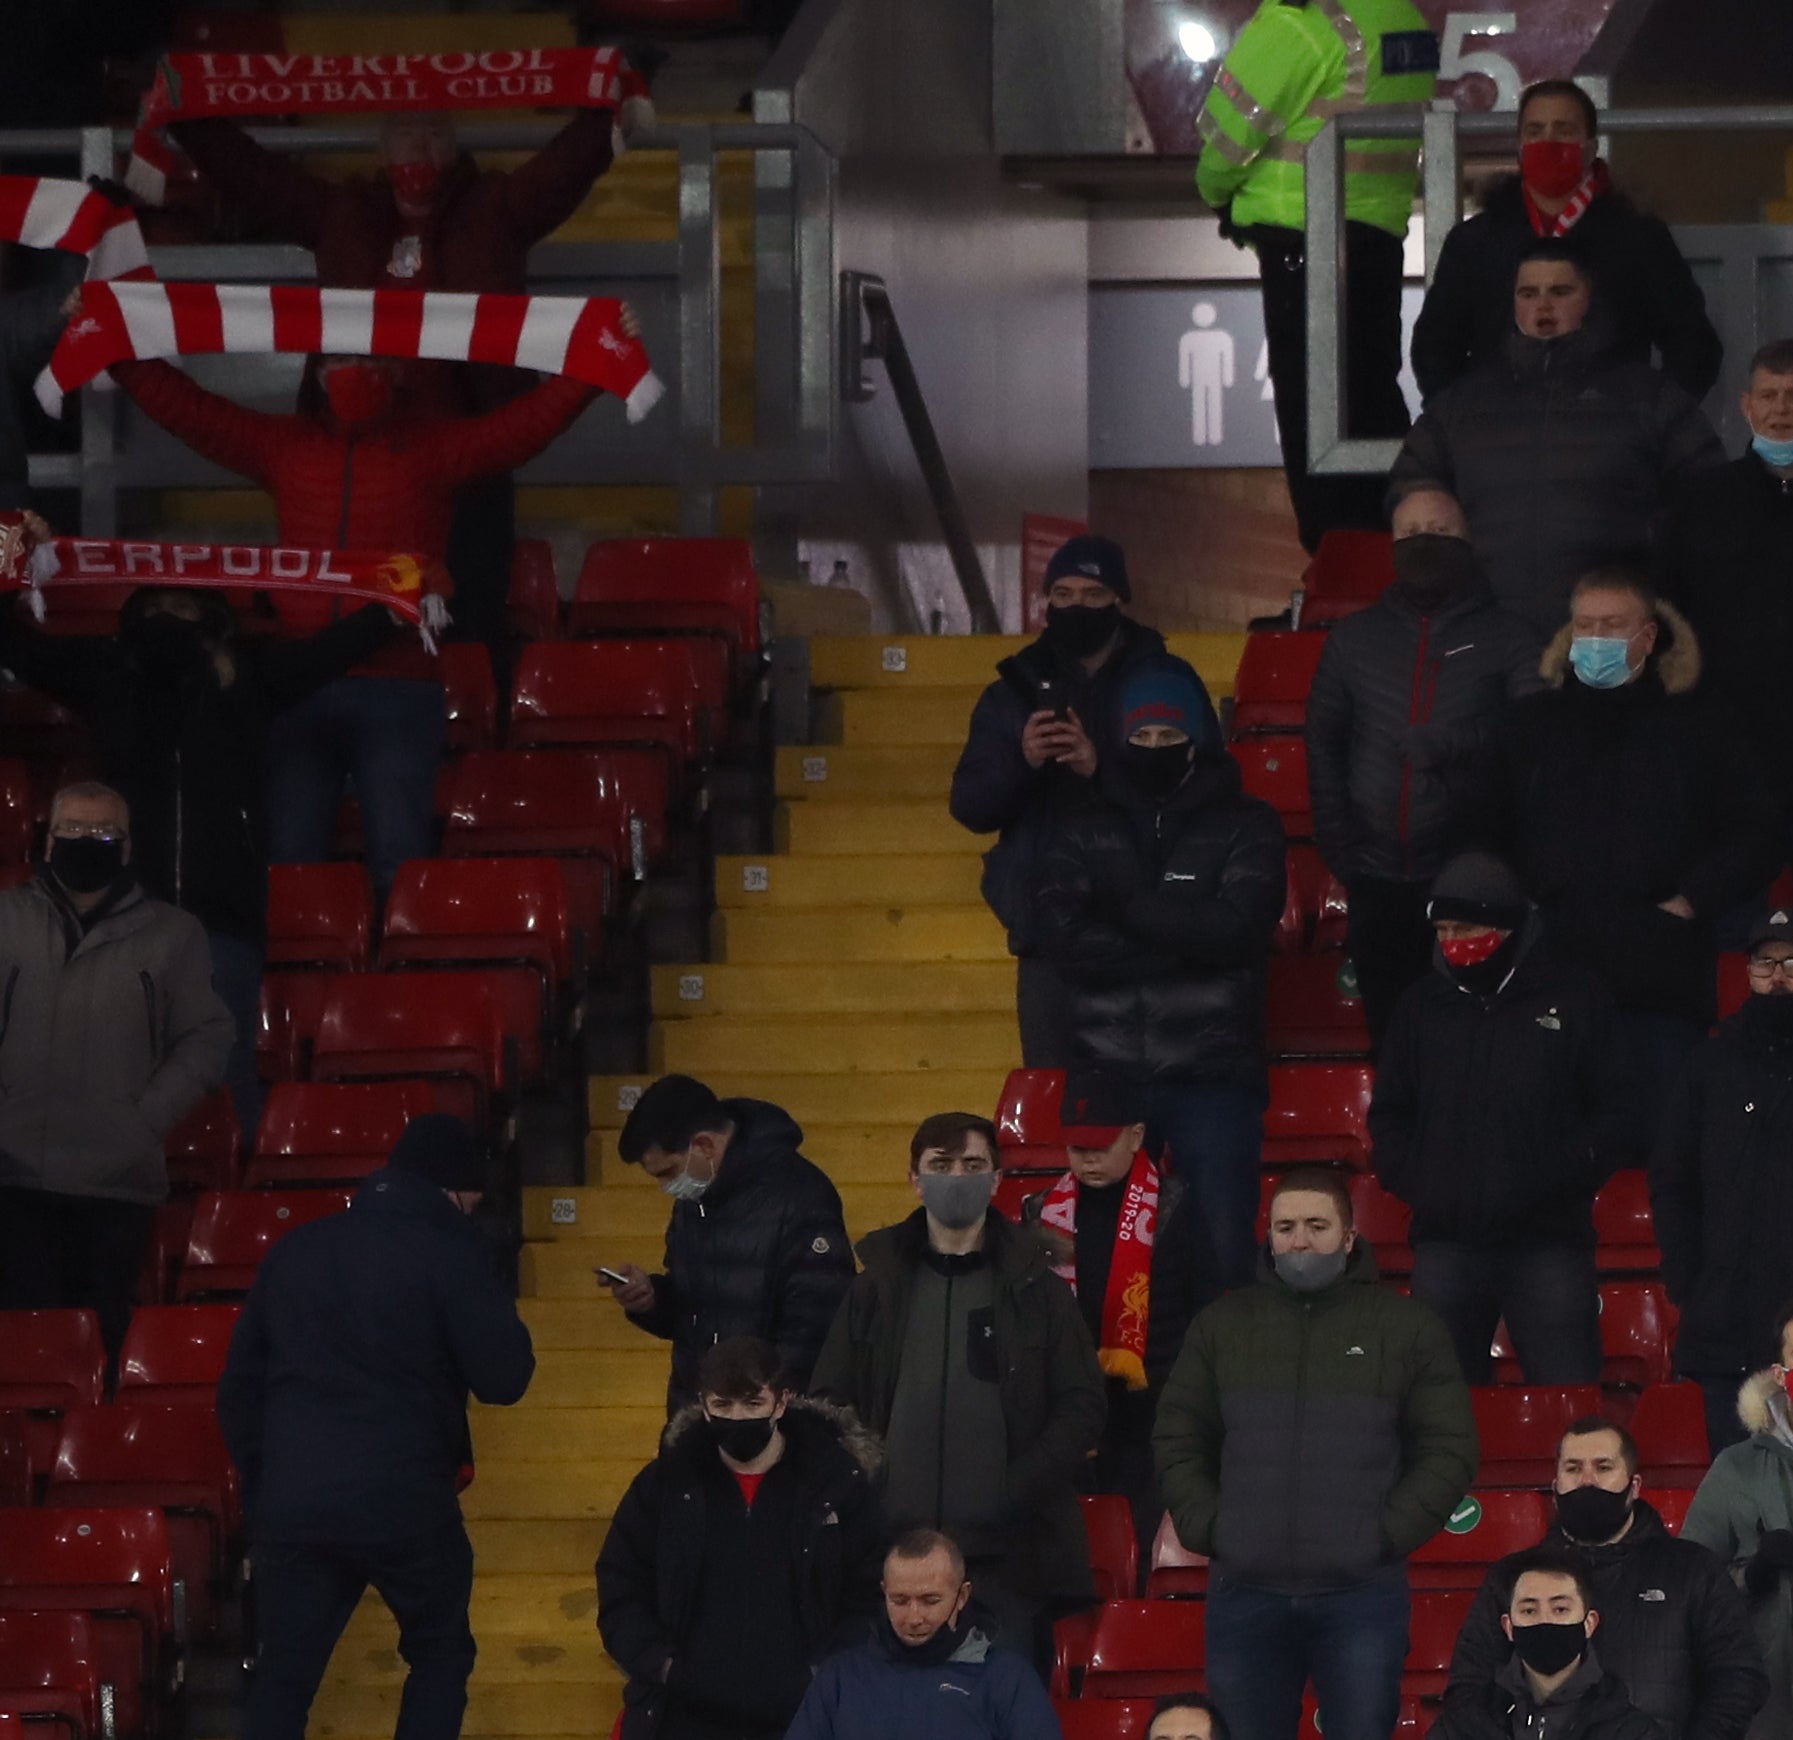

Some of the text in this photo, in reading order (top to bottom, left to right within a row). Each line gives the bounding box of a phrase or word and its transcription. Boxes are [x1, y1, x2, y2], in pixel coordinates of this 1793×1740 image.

[198, 50, 558, 81] LIVERPOOL
[208, 74, 554, 105] FOOTBALL CLUB
[554, 1203, 572, 1219] 28
[1119, 1185, 1143, 1242] 2019-20
